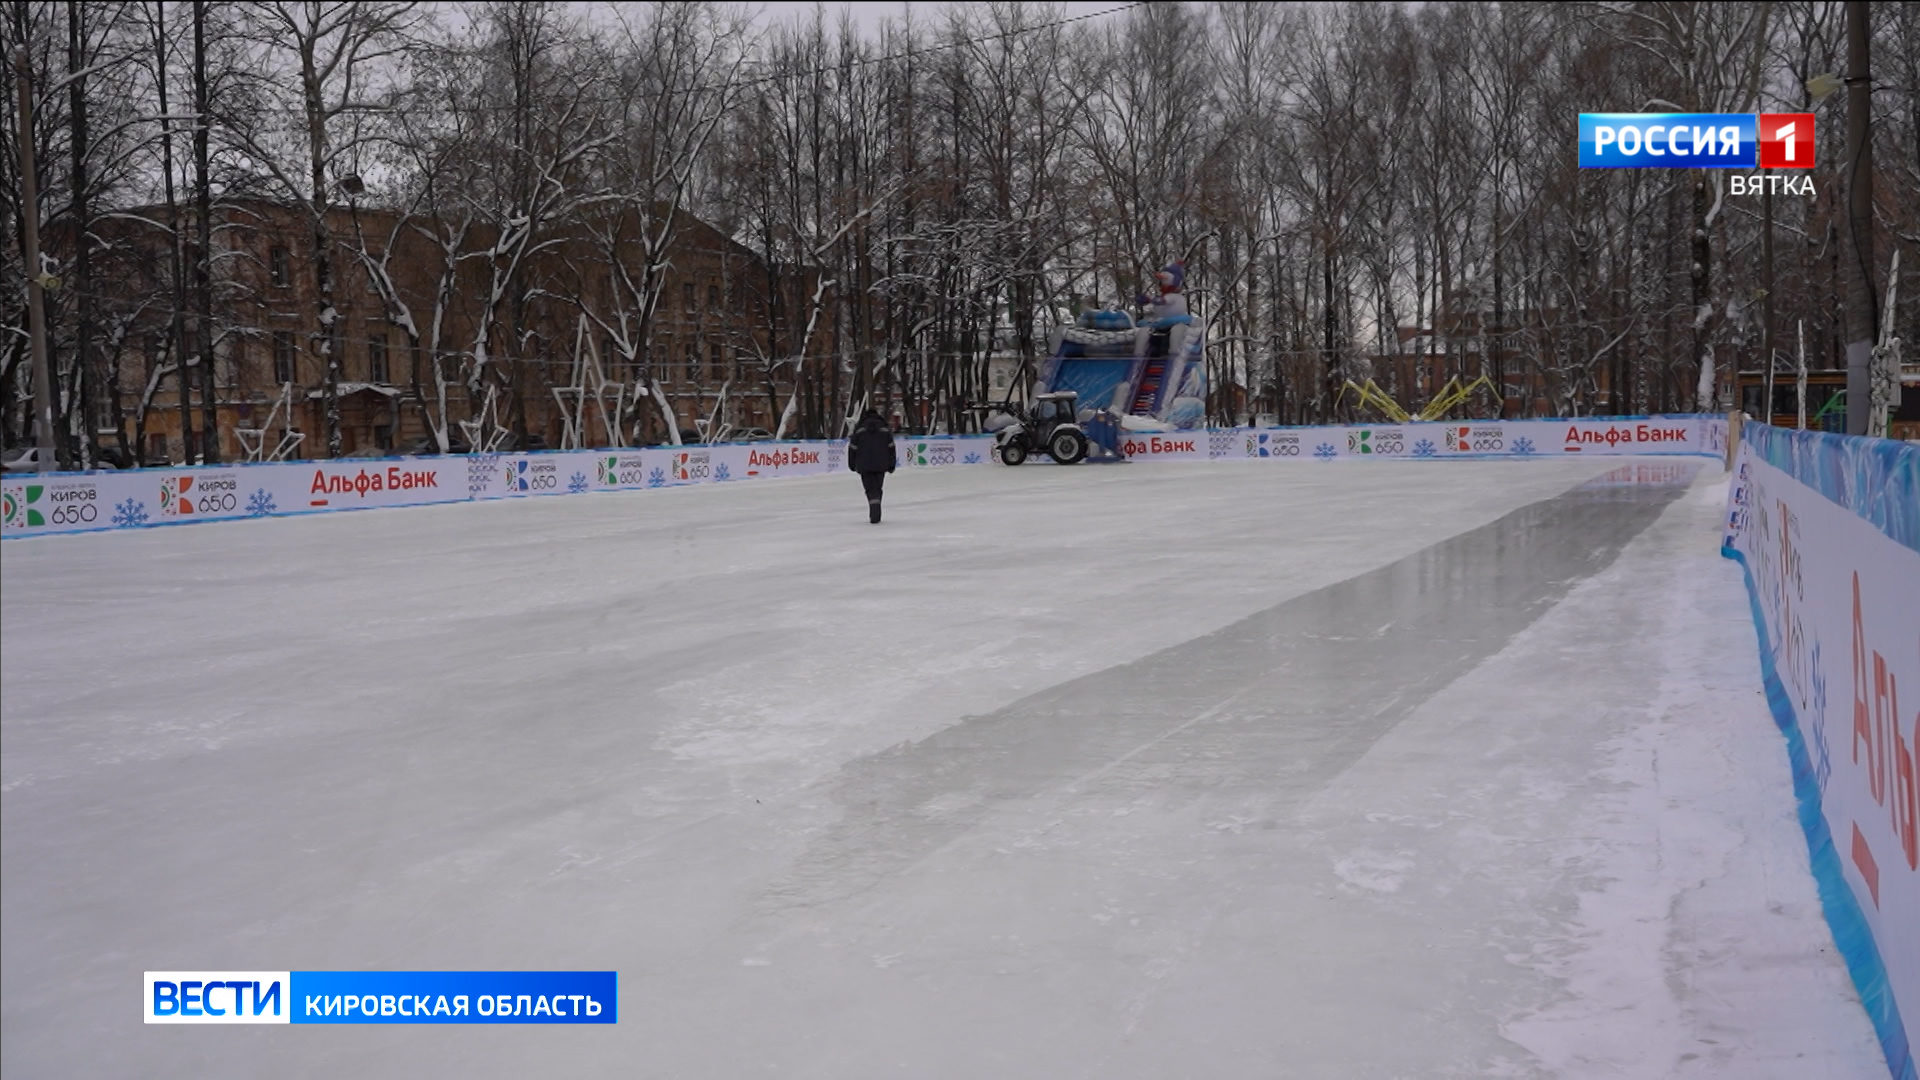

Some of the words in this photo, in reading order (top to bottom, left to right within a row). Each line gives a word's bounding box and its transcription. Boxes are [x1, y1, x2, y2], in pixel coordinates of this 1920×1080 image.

[1151, 437, 1196, 454] Банк
[1565, 426, 1632, 447] Альфа
[1636, 425, 1688, 442] Банк
[748, 448, 789, 469] Альфа
[791, 447, 820, 464] Банк
[198, 480, 237, 492] КИРОВ
[310, 469, 384, 498] Альфа
[387, 467, 438, 490] Банк
[50, 489, 97, 502] КИРОВ
[198, 493, 237, 513] 650
[51, 503, 98, 524] 650
[1852, 569, 1920, 872] Аль
